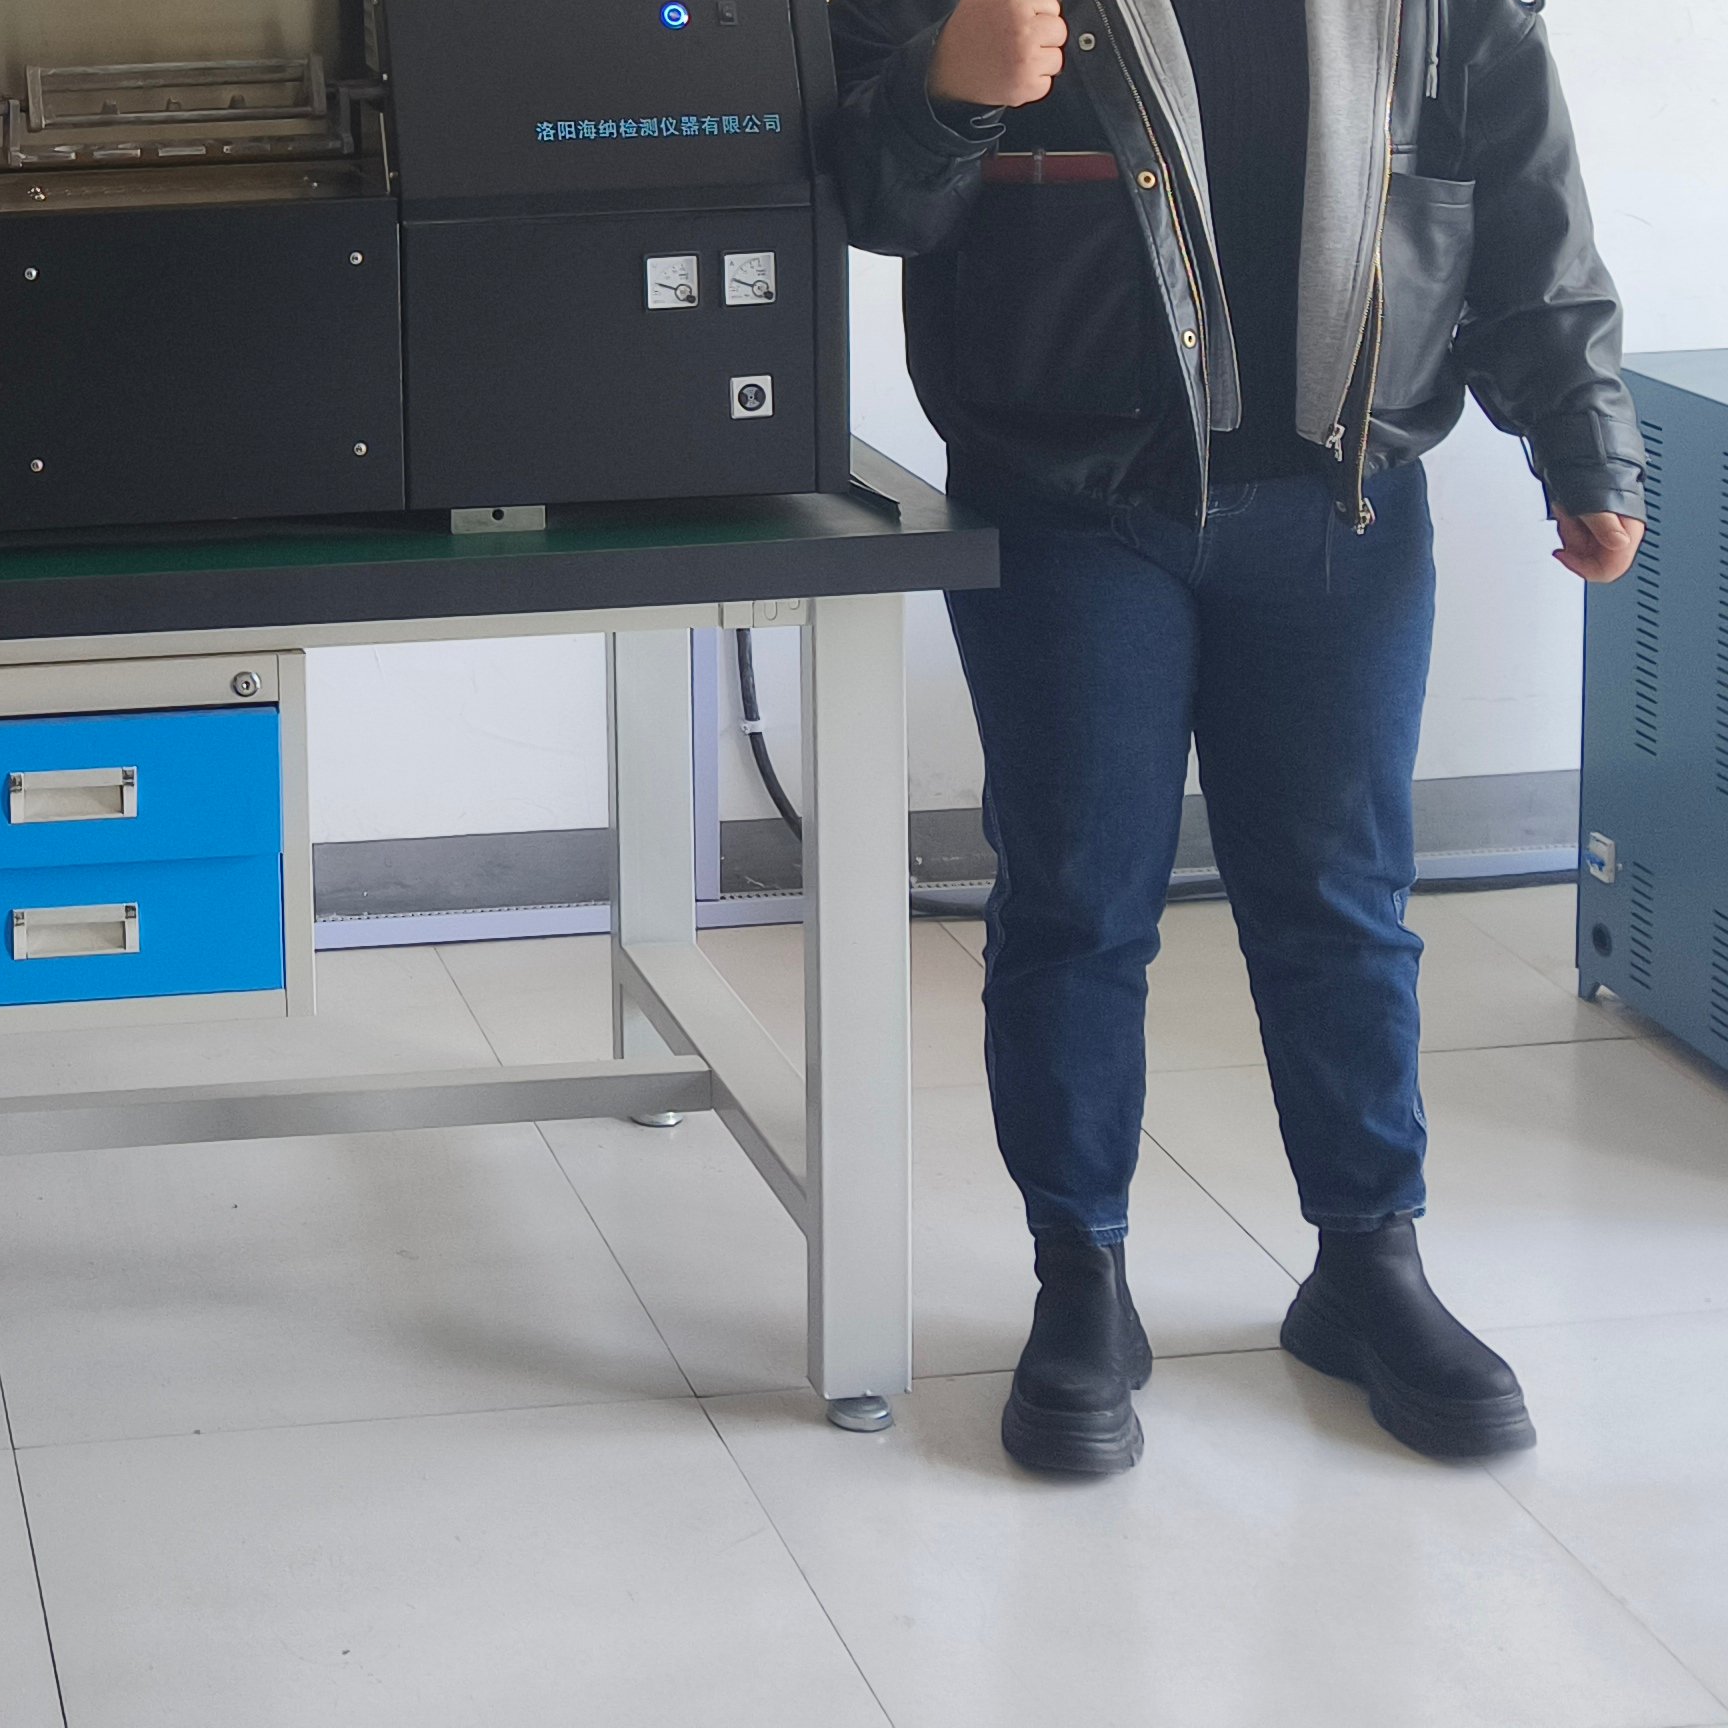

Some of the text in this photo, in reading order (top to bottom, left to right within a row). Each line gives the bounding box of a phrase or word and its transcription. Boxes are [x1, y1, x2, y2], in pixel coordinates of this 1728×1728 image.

[535, 114, 781, 142] 洛阳海纳检测仪器有限公司
